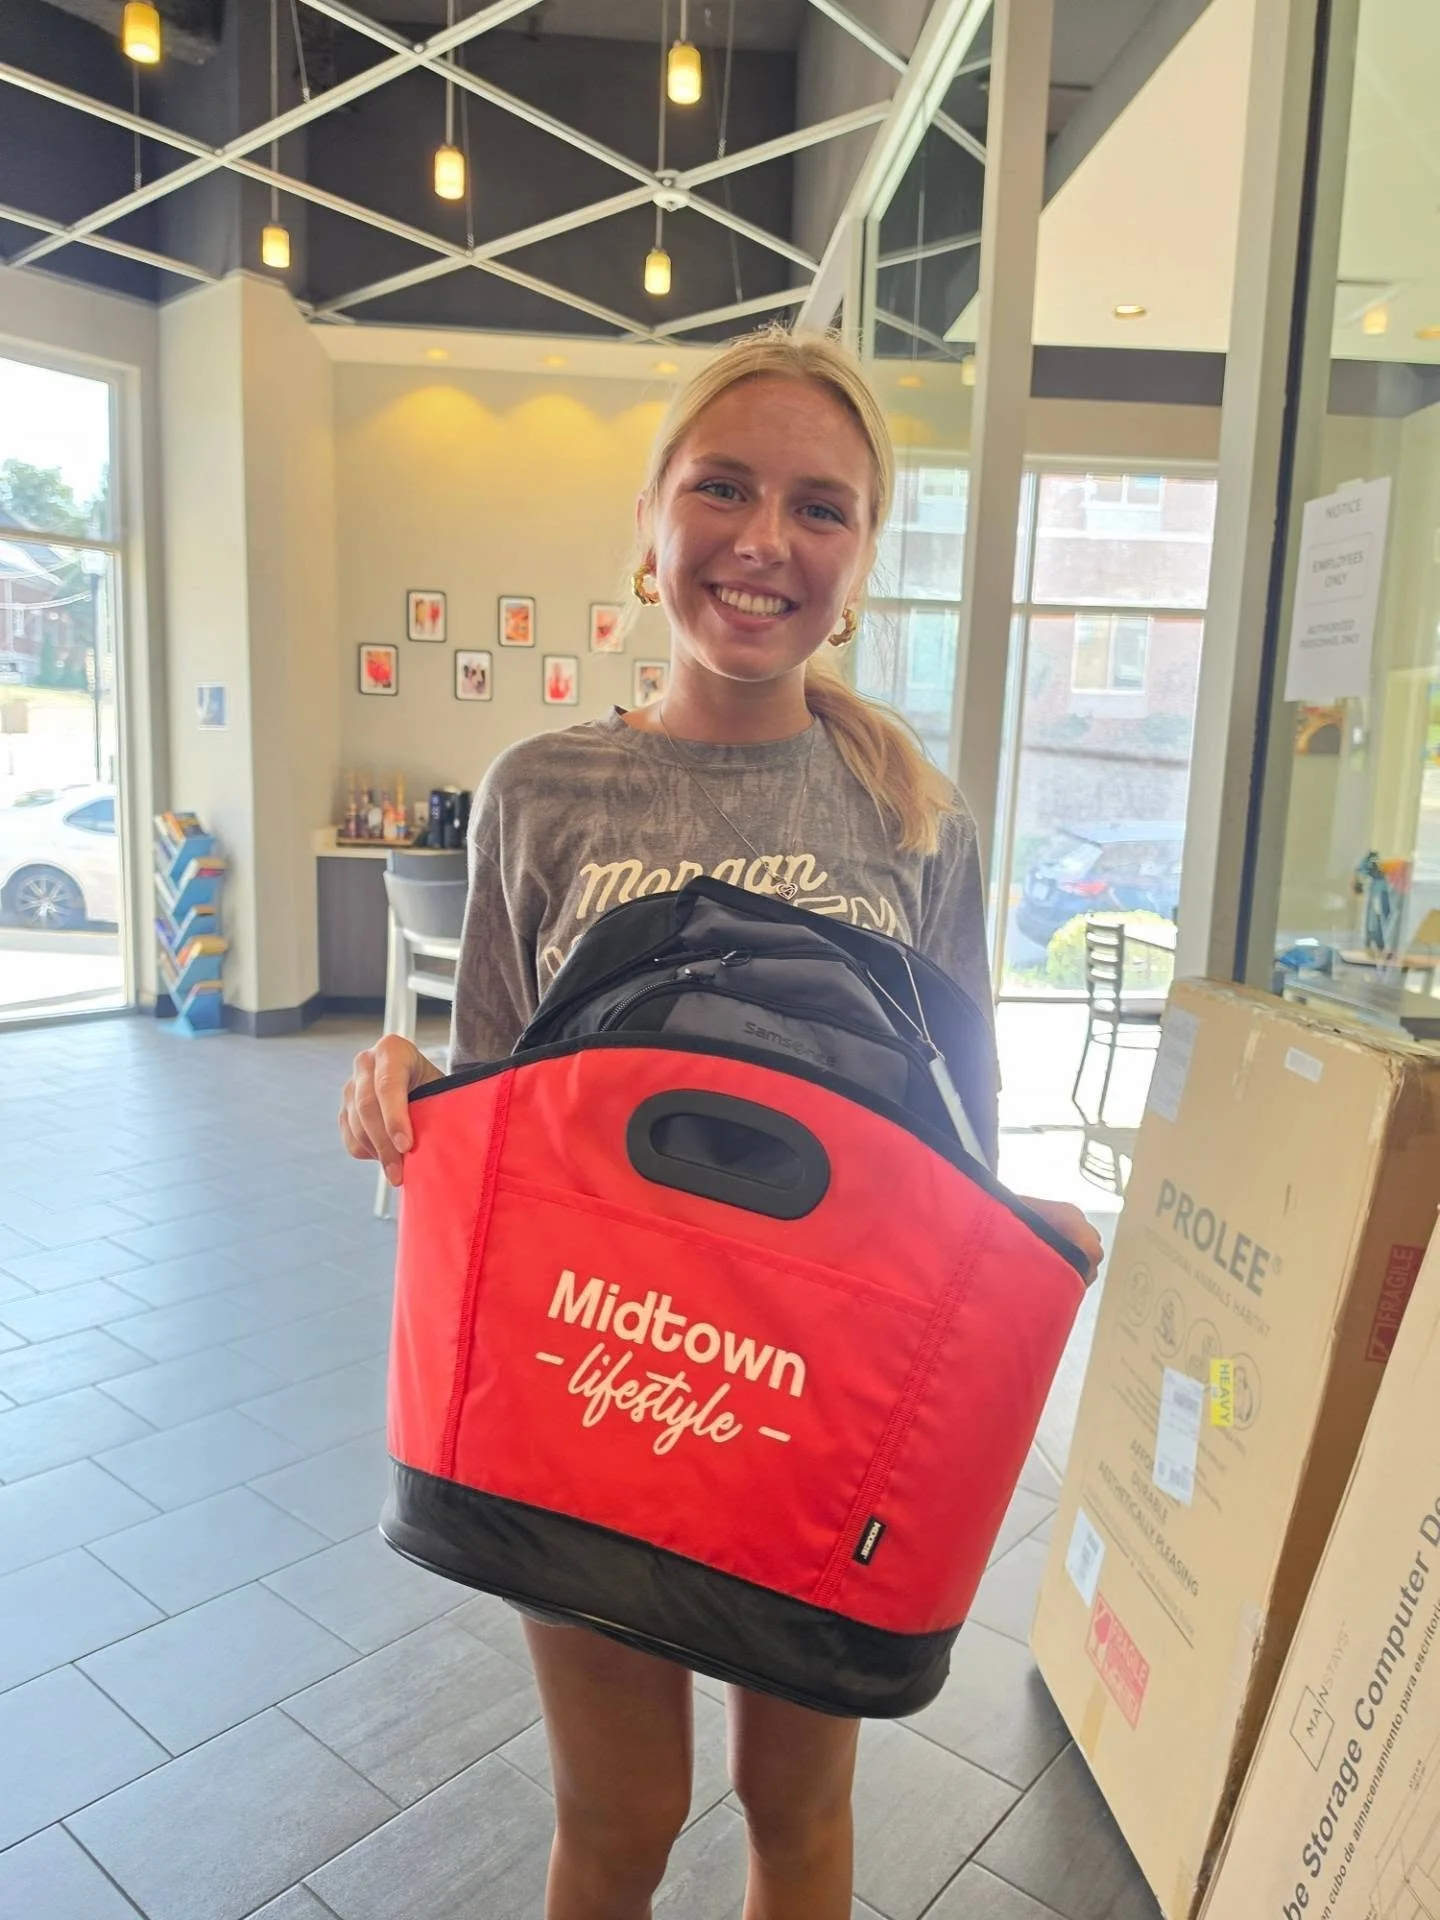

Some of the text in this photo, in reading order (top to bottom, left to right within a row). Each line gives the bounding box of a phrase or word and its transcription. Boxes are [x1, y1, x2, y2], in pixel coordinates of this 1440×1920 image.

[1325, 498, 1363, 520] NOTICE
[1155, 1178, 1272, 1297] PROLEE
[547, 1269, 807, 1398] Midtown
[1219, 1362, 1232, 1424] HEAVY
[567, 1342, 743, 1455] lifestyle
[1302, 1738, 1363, 1878] Storage
[1355, 1550, 1430, 1731] Computer
[1329, 1864, 1347, 1905] cubo
[1344, 1842, 1356, 1863] de
[1352, 1713, 1403, 1842] almacenamiento
[1399, 1674, 1417, 1715] para
[1415, 1598, 1440, 1673] escritori
